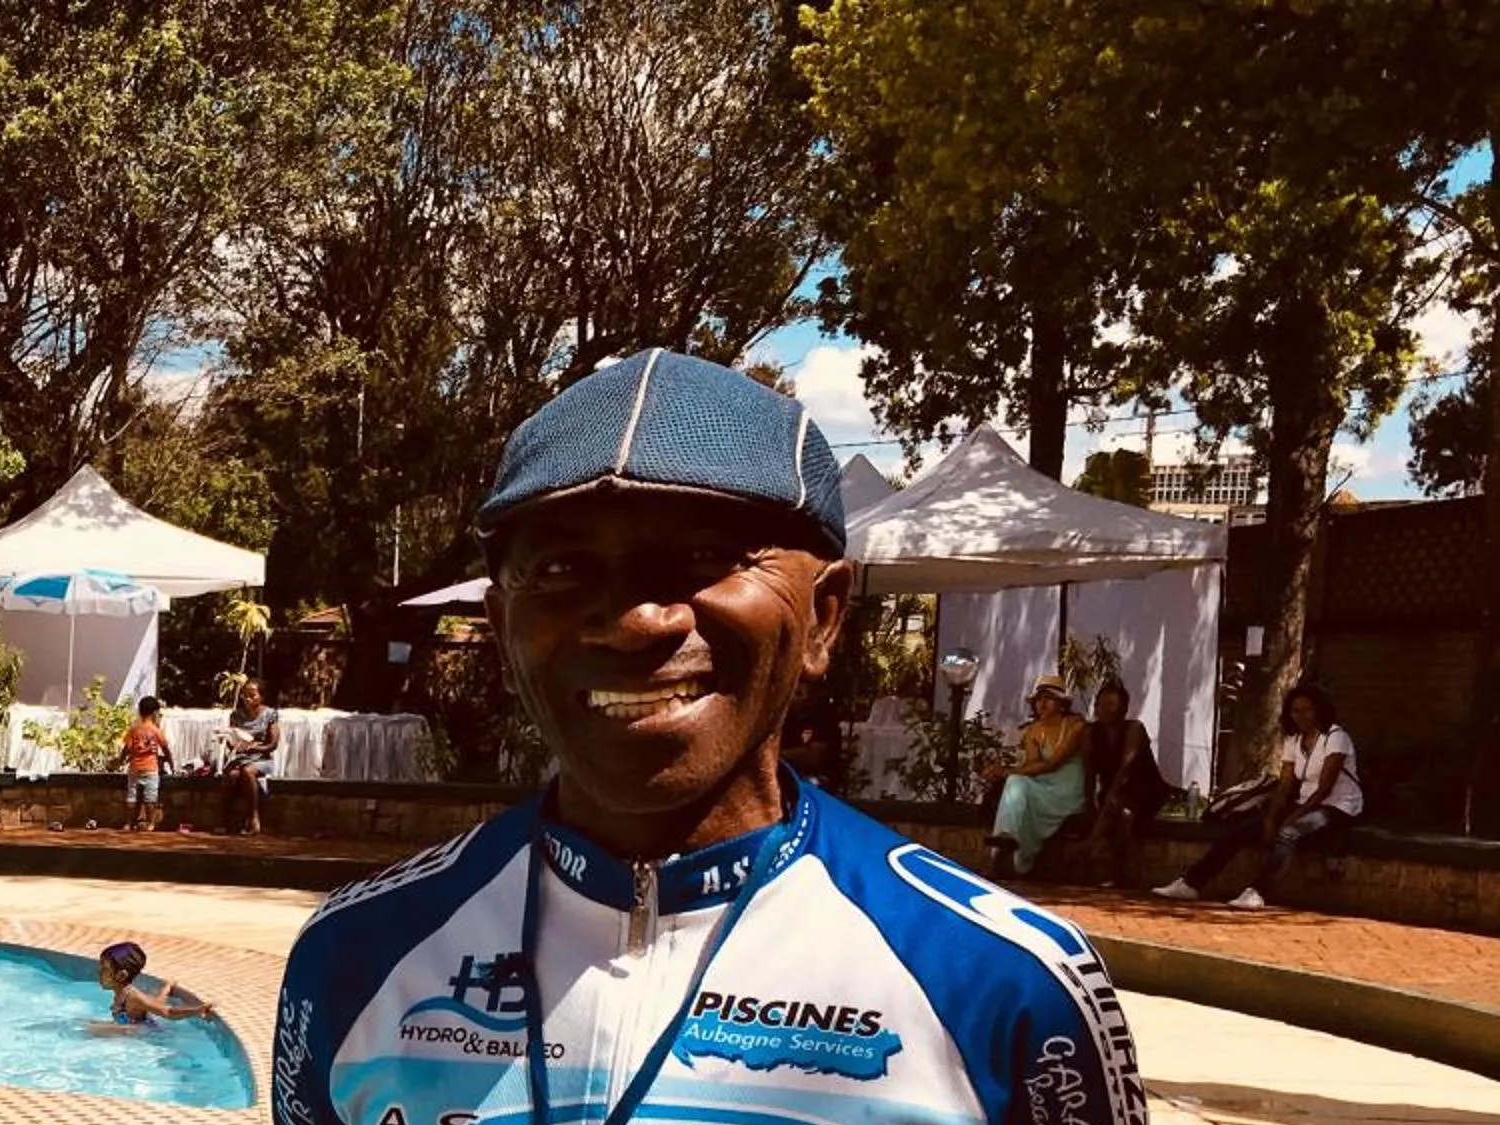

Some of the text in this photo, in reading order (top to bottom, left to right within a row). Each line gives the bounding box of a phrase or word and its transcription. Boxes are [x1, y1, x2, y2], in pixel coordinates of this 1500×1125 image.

[692, 991, 883, 1037] PISCINES
[401, 1025, 467, 1044] HYDRO
[486, 1039, 565, 1060] BALEO
[685, 1023, 874, 1059] Aubagne Services
